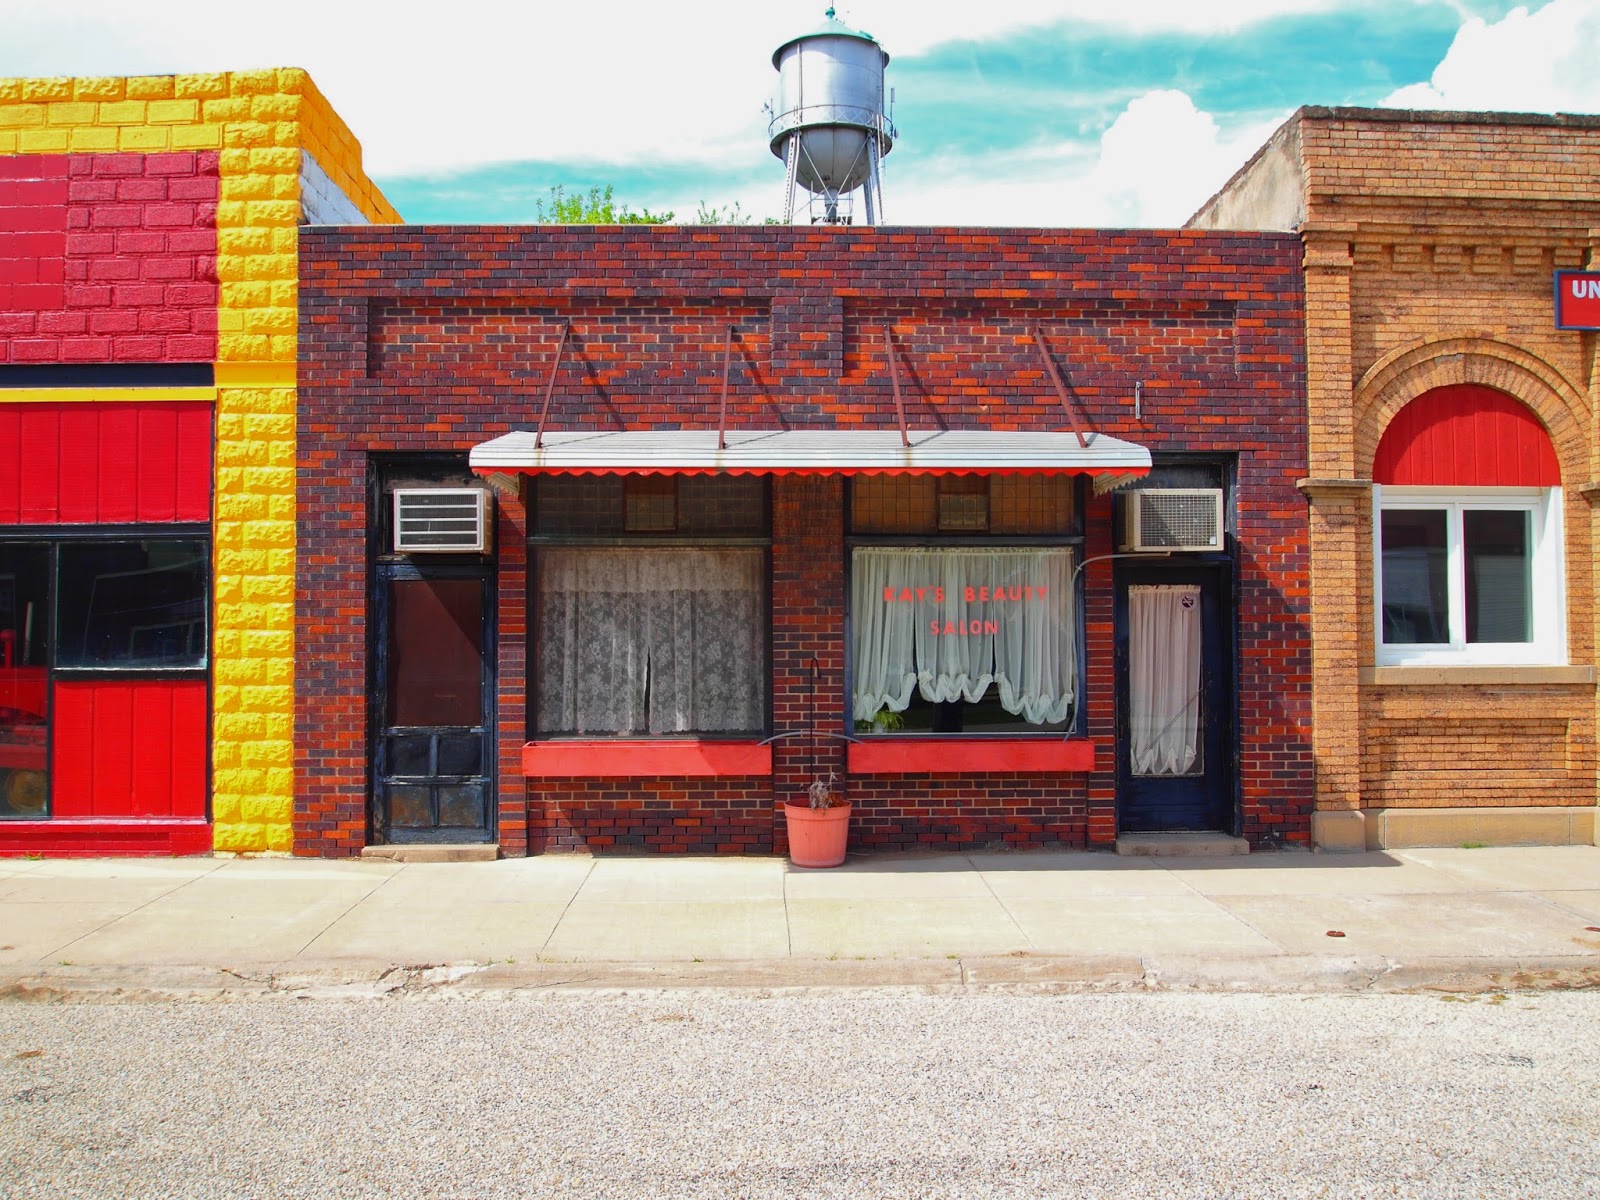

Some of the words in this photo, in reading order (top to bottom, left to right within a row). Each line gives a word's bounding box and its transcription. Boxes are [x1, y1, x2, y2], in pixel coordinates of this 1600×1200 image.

[883, 586, 945, 602] KAY'S
[964, 586, 1048, 602] BEAUTY
[930, 620, 999, 636] SALON
